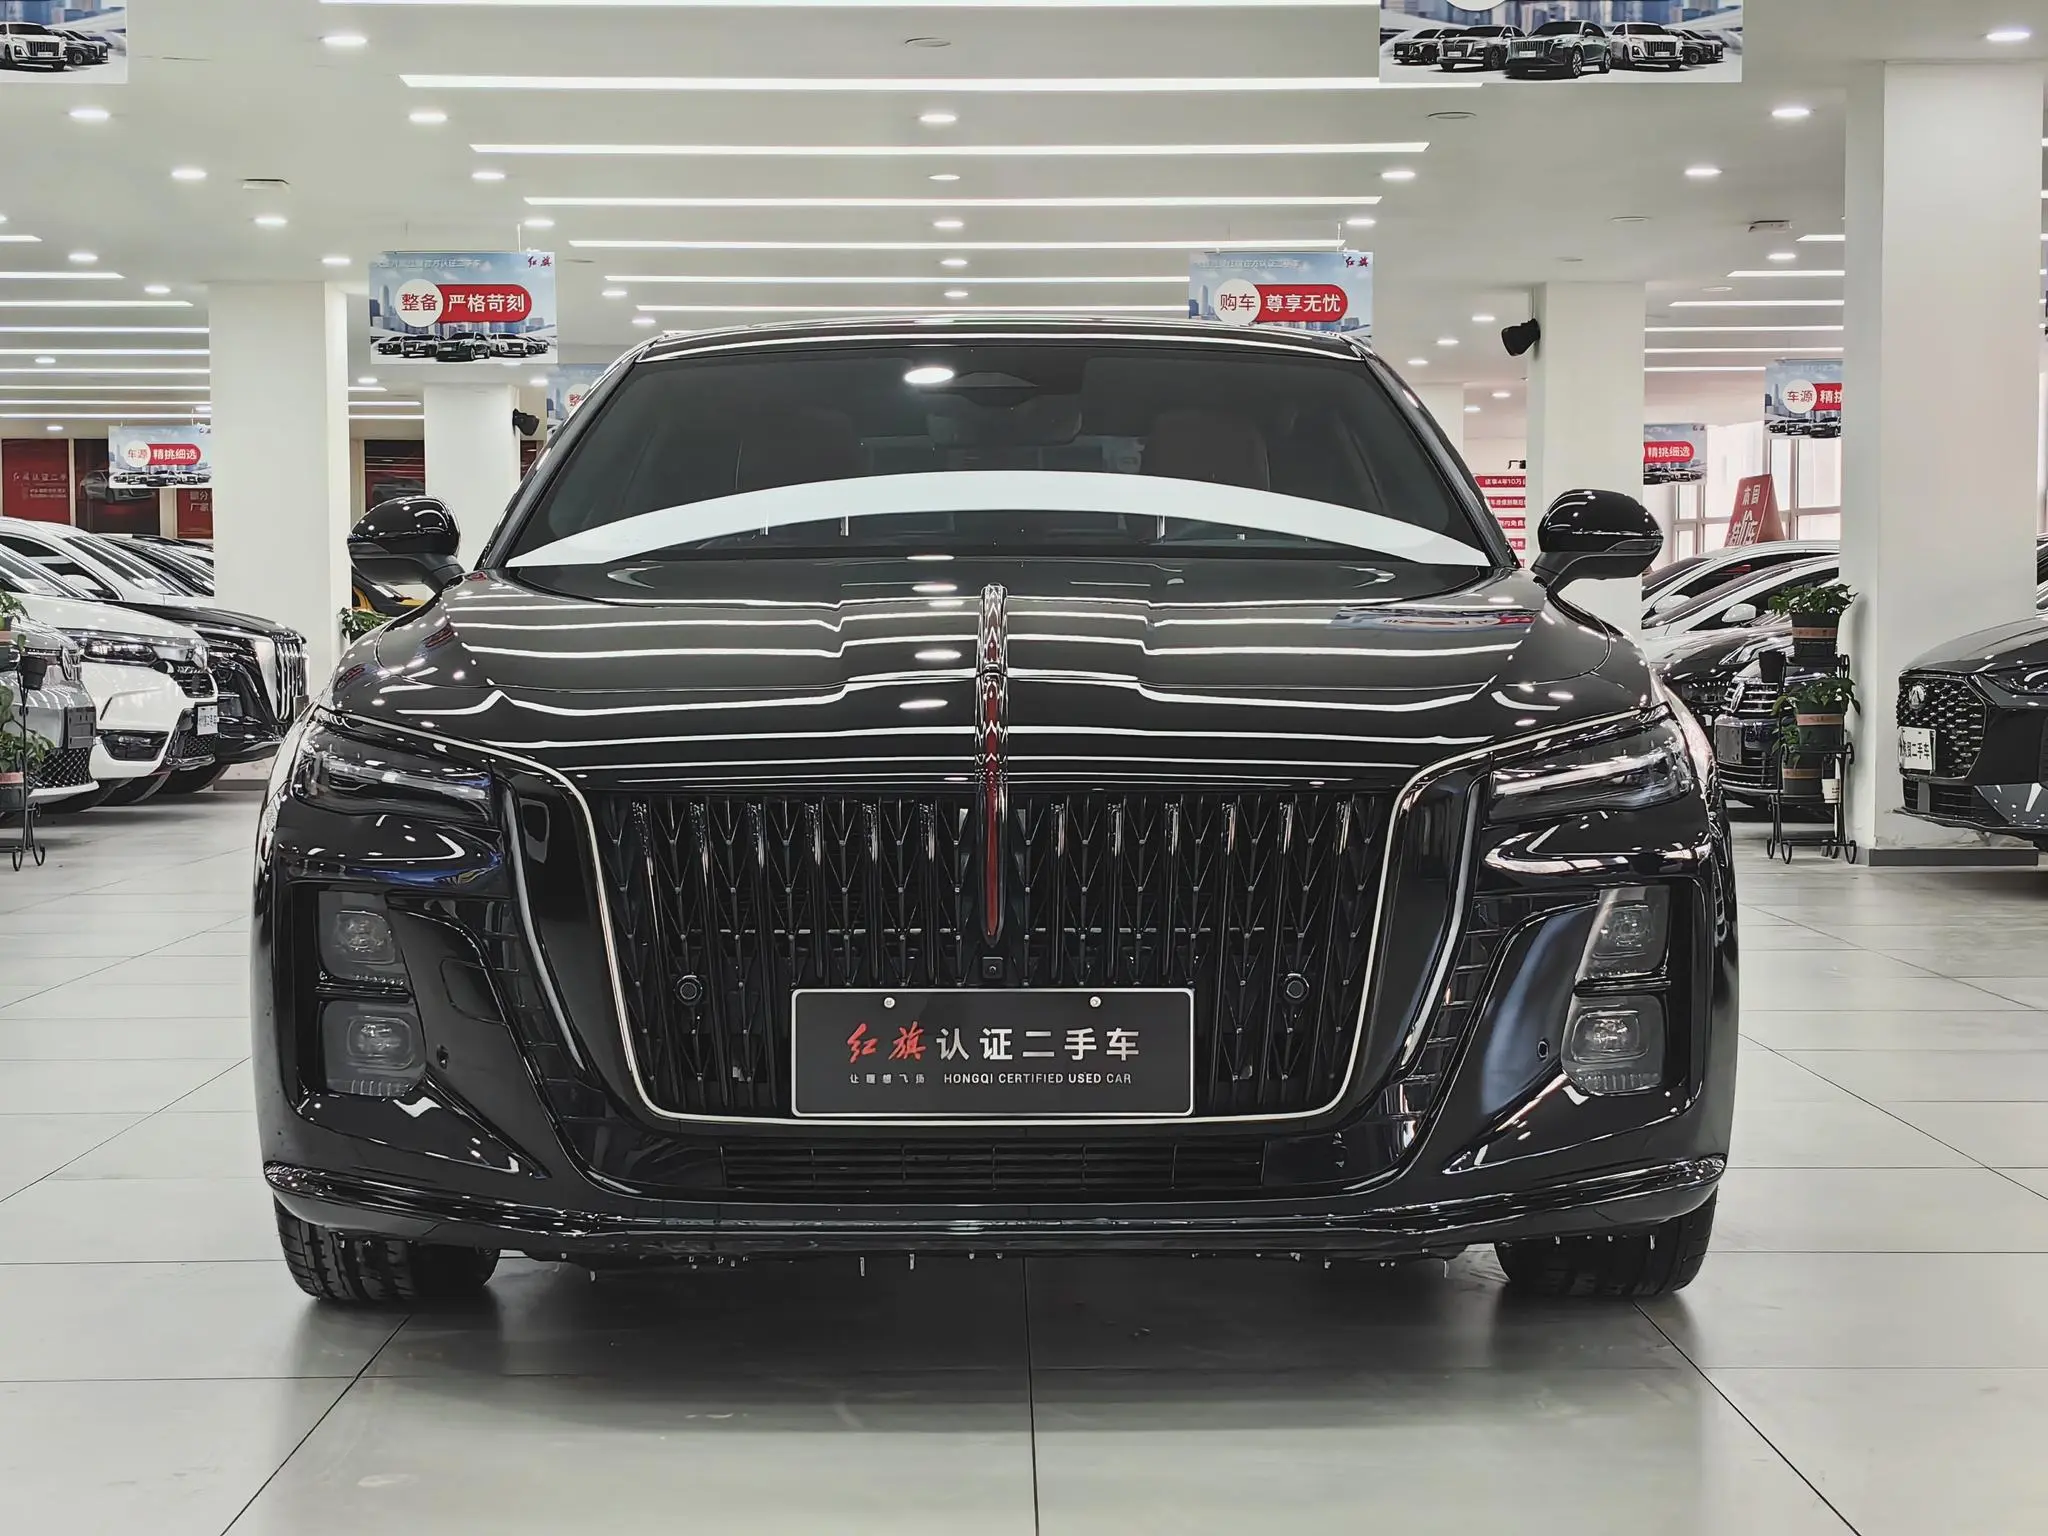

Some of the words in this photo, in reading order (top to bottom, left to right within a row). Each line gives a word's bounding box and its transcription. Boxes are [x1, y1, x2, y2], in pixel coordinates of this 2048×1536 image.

[527, 255, 552, 268] 红旗
[1345, 255, 1369, 268] 红旗
[401, 293, 438, 312] 整备
[448, 293, 525, 313] 严格苛刻
[1220, 293, 1256, 312] 购车
[1265, 293, 1341, 313] 尊享无忧
[1787, 390, 1813, 403] 车源
[153, 448, 197, 460] 精挑细选
[846, 1021, 1140, 1064] 红旗认证二手车
[943, 1072, 994, 1085] HONGQI
[998, 1072, 1064, 1085] CERTIFIED
[1068, 1072, 1102, 1085] USED
[1106, 1072, 1132, 1085] CAR
